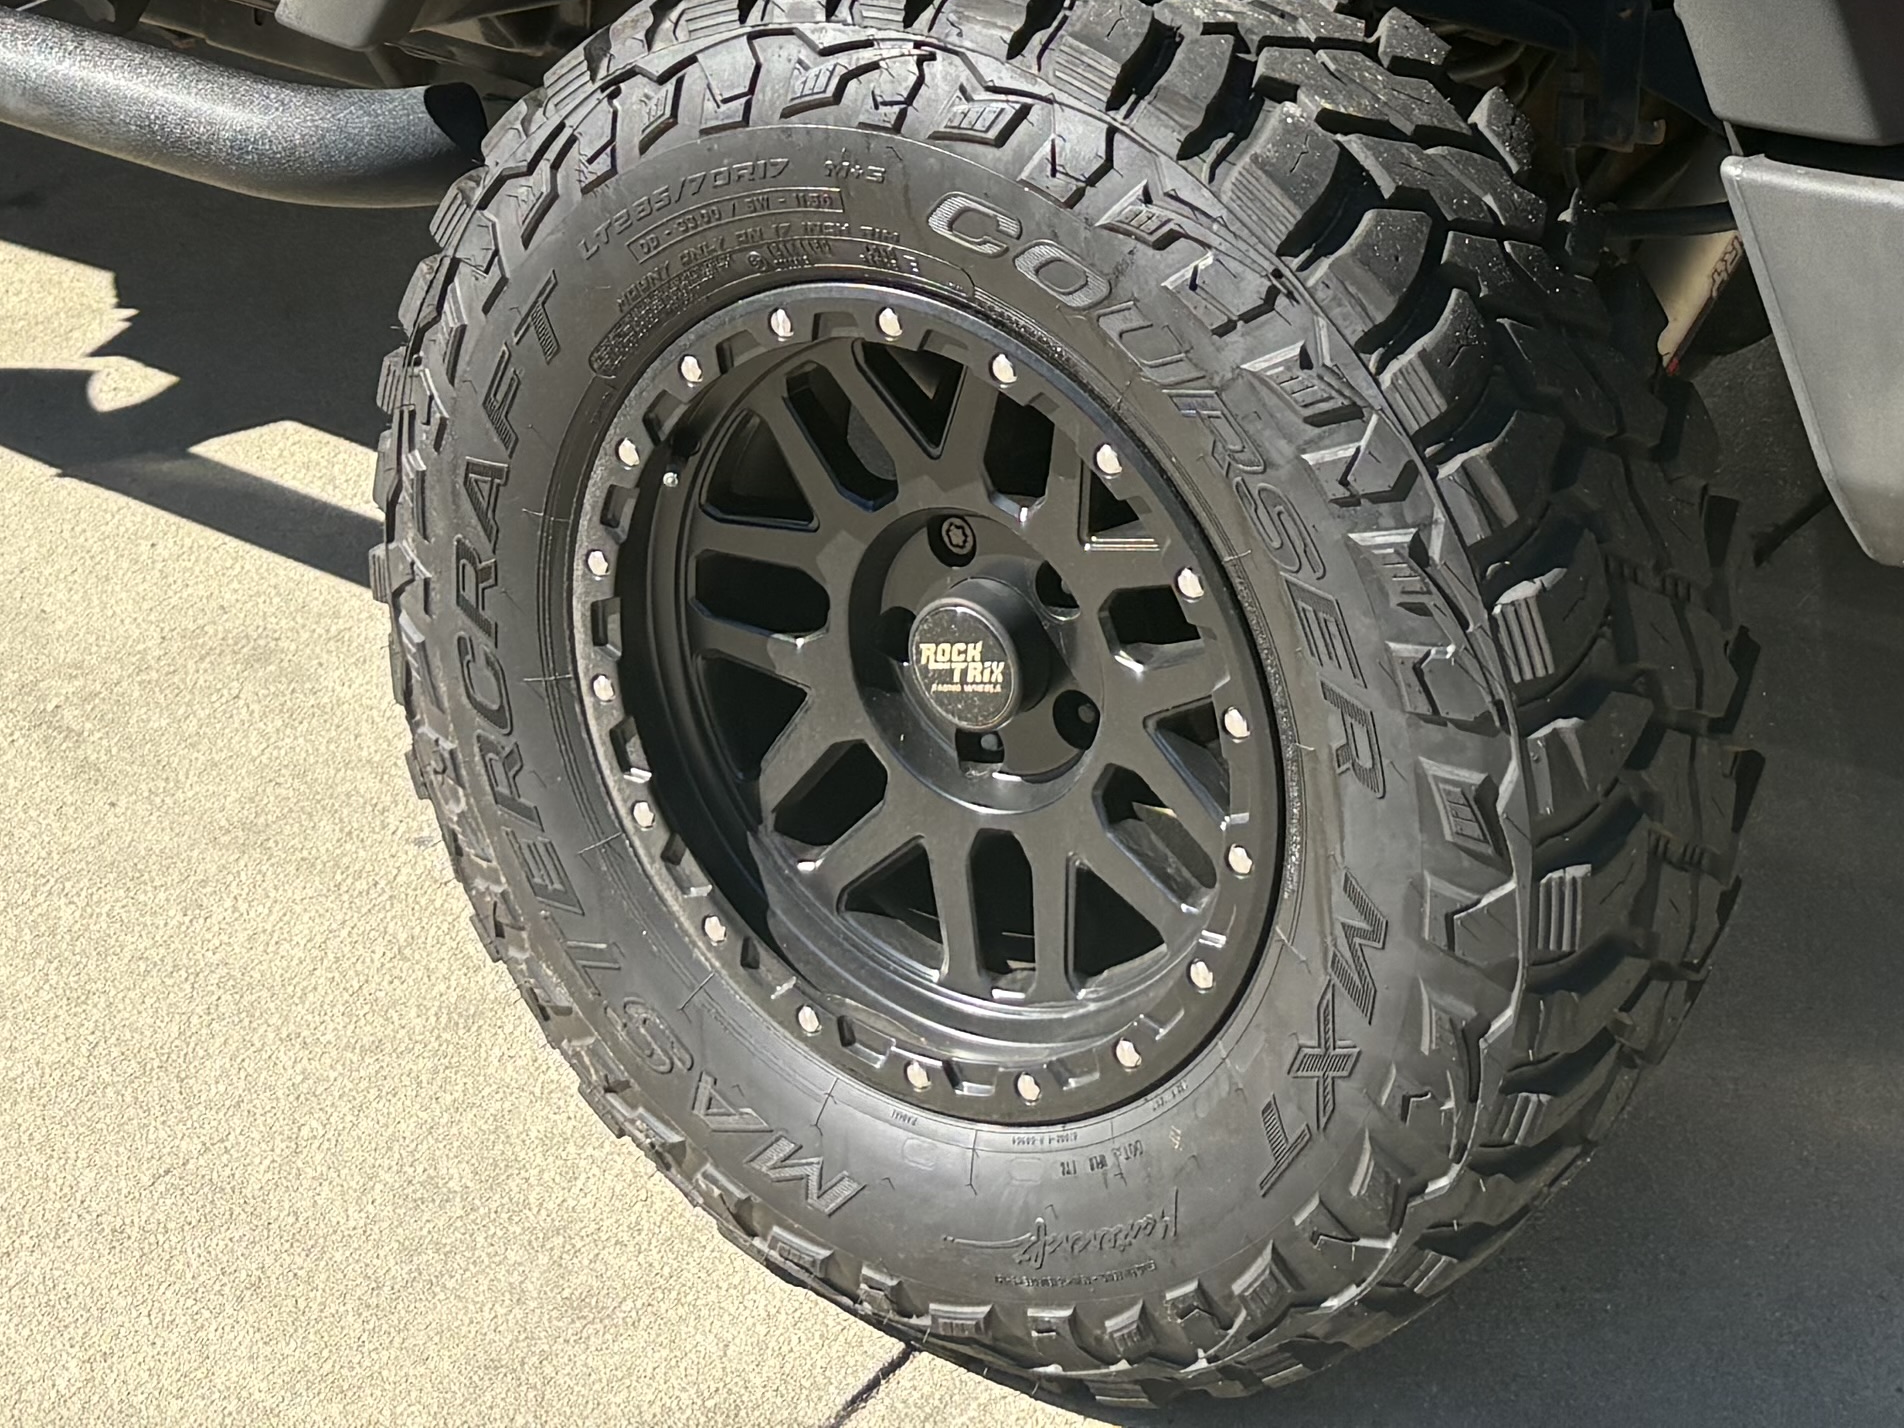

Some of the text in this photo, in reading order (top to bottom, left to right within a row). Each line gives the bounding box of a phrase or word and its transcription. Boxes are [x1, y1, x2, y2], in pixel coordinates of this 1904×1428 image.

[616, 260, 671, 312] MOUNT
[679, 235, 725, 266] ONLY
[771, 222, 791, 239] 17
[800, 220, 851, 236] INCH
[454, 269, 867, 1219] MASTERCRAFT
[919, 641, 983, 670] ROCK
[928, 191, 1389, 1198] COURSER MXT
